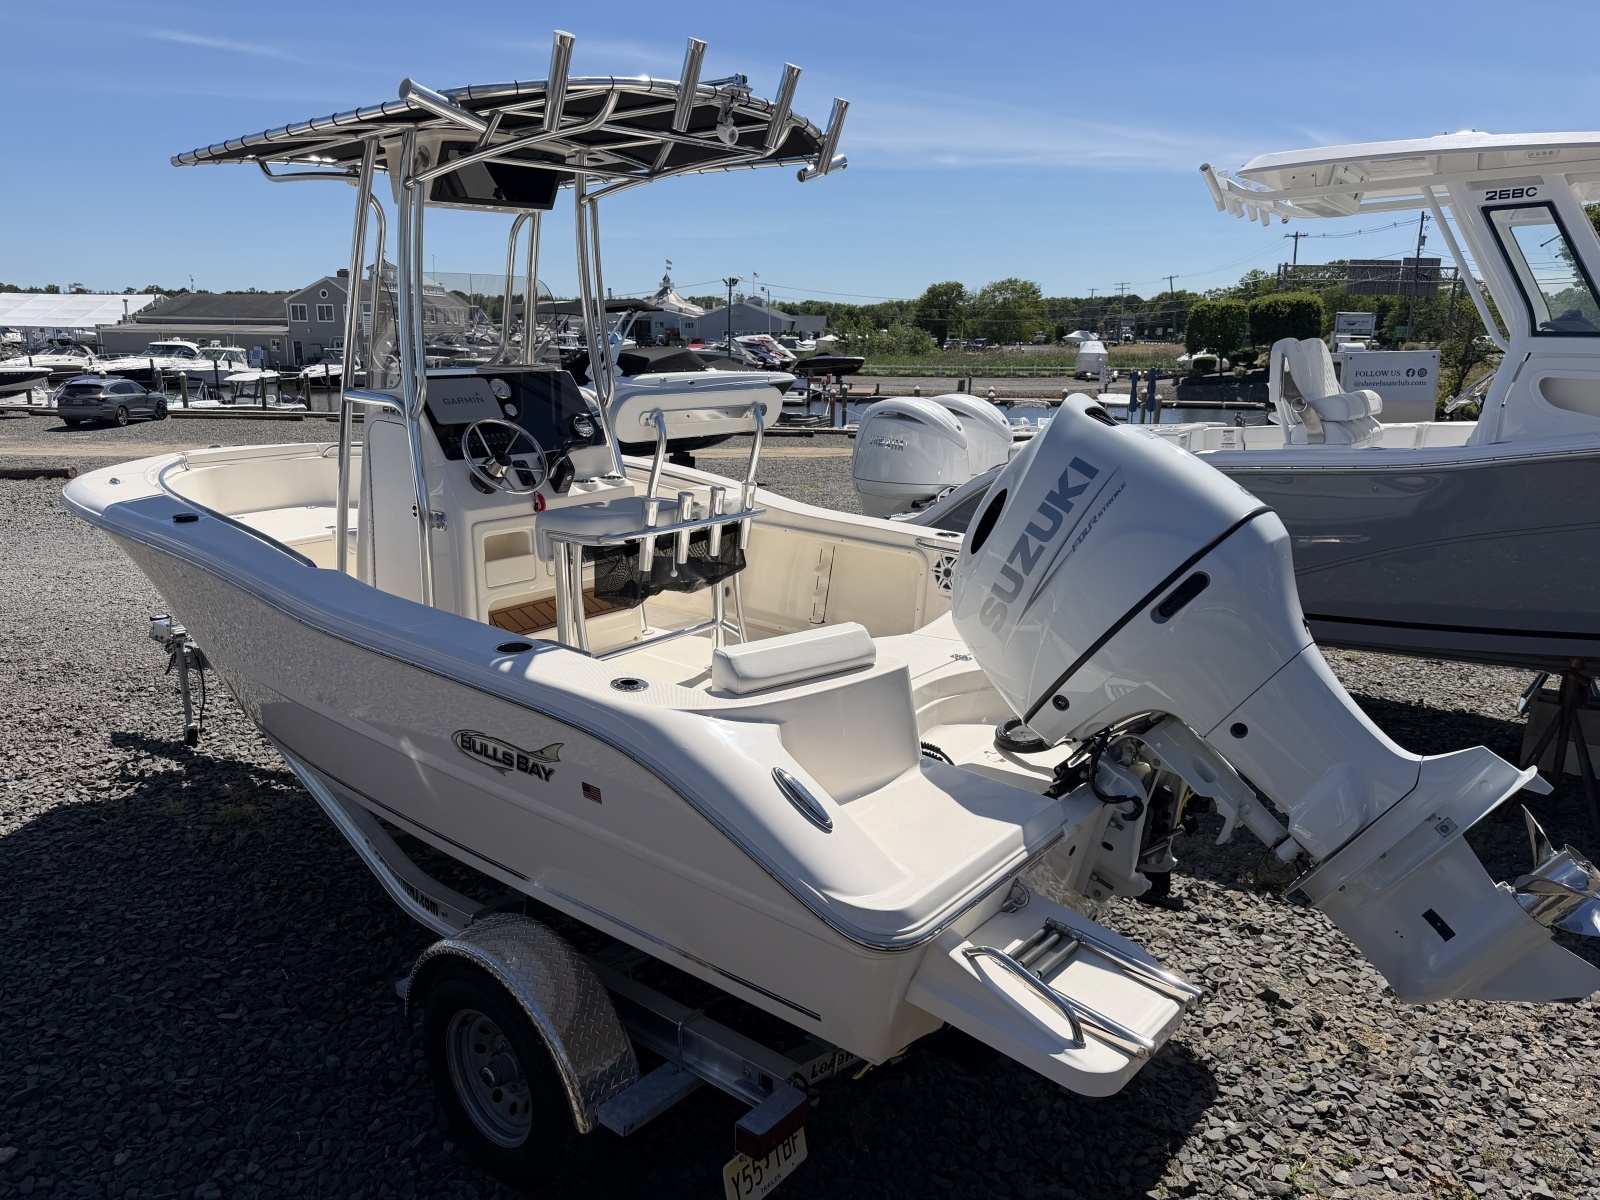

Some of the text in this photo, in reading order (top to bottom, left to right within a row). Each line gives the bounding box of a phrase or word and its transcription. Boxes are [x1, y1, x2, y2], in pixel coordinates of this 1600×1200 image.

[442, 396, 485, 405] GARMIN
[869, 434, 906, 452] YAMAHA
[979, 456, 1100, 634] SUZUKI
[760, 1173, 782, 1194] TRAILER
